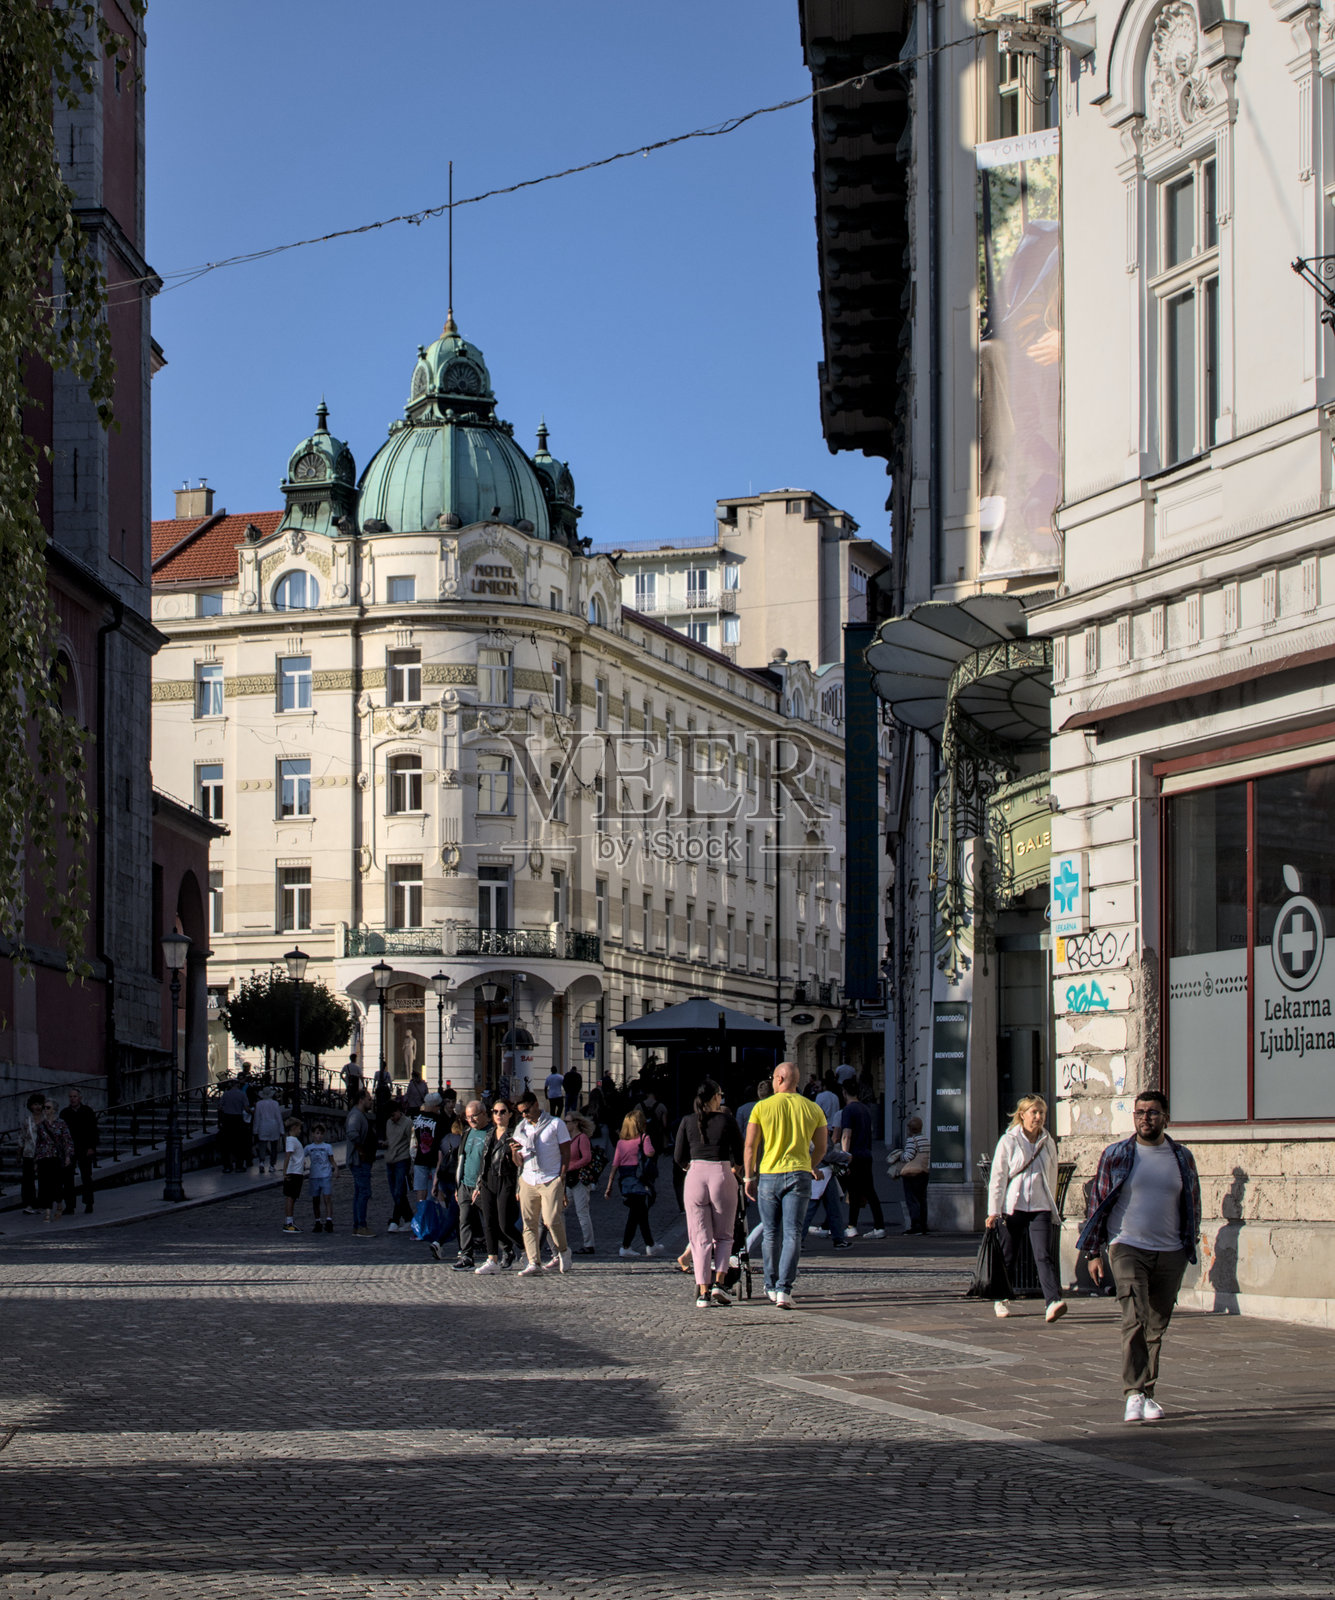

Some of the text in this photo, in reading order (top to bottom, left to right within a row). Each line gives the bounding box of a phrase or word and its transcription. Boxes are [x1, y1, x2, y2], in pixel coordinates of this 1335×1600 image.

[991, 137, 1048, 156] TOMMY
[475, 564, 515, 579] HOTEL
[471, 579, 518, 596] UNION
[1016, 832, 1051, 856] GALE
[1056, 922, 1077, 933] LEKARNA
[1264, 995, 1332, 1021] Lekarna
[1260, 1026, 1335, 1060] Ljubljana
[935, 1051, 965, 1059] BIENVENIDOS
[931, 1161, 963, 1169] WILLKOMMEN
